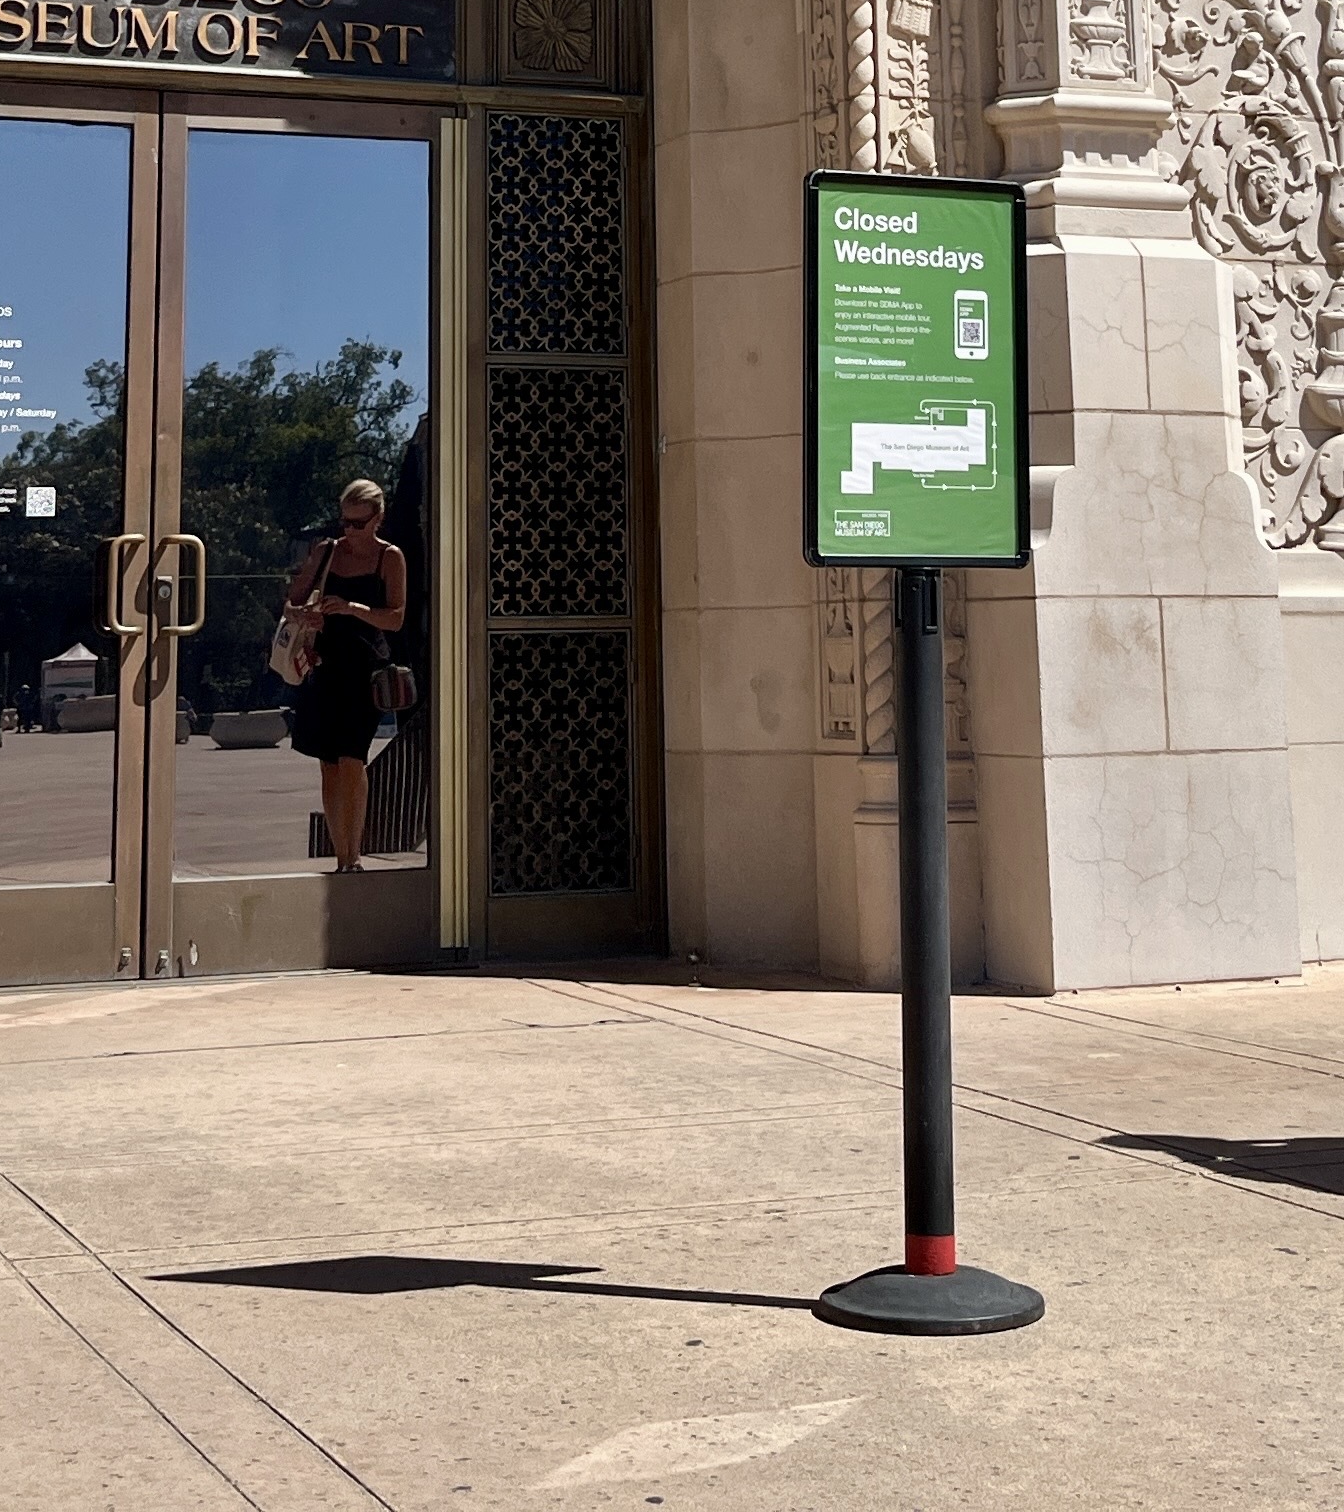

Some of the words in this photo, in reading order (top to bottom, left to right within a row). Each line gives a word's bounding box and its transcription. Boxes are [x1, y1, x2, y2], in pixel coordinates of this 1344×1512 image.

[197, 12, 284, 57] OF
[295, 19, 424, 65] ART
[834, 206, 918, 234] Closed
[833, 239, 984, 274] Wednesdays
[3, 375, 23, 384] p.m.
[16, 408, 57, 419] Saturday
[1, 424, 22, 433] p.m.
[836, 521, 848, 529] THE
[850, 521, 863, 529] SAN
[864, 521, 884, 529] DIEGO
[835, 528, 864, 536] MUSEUM
